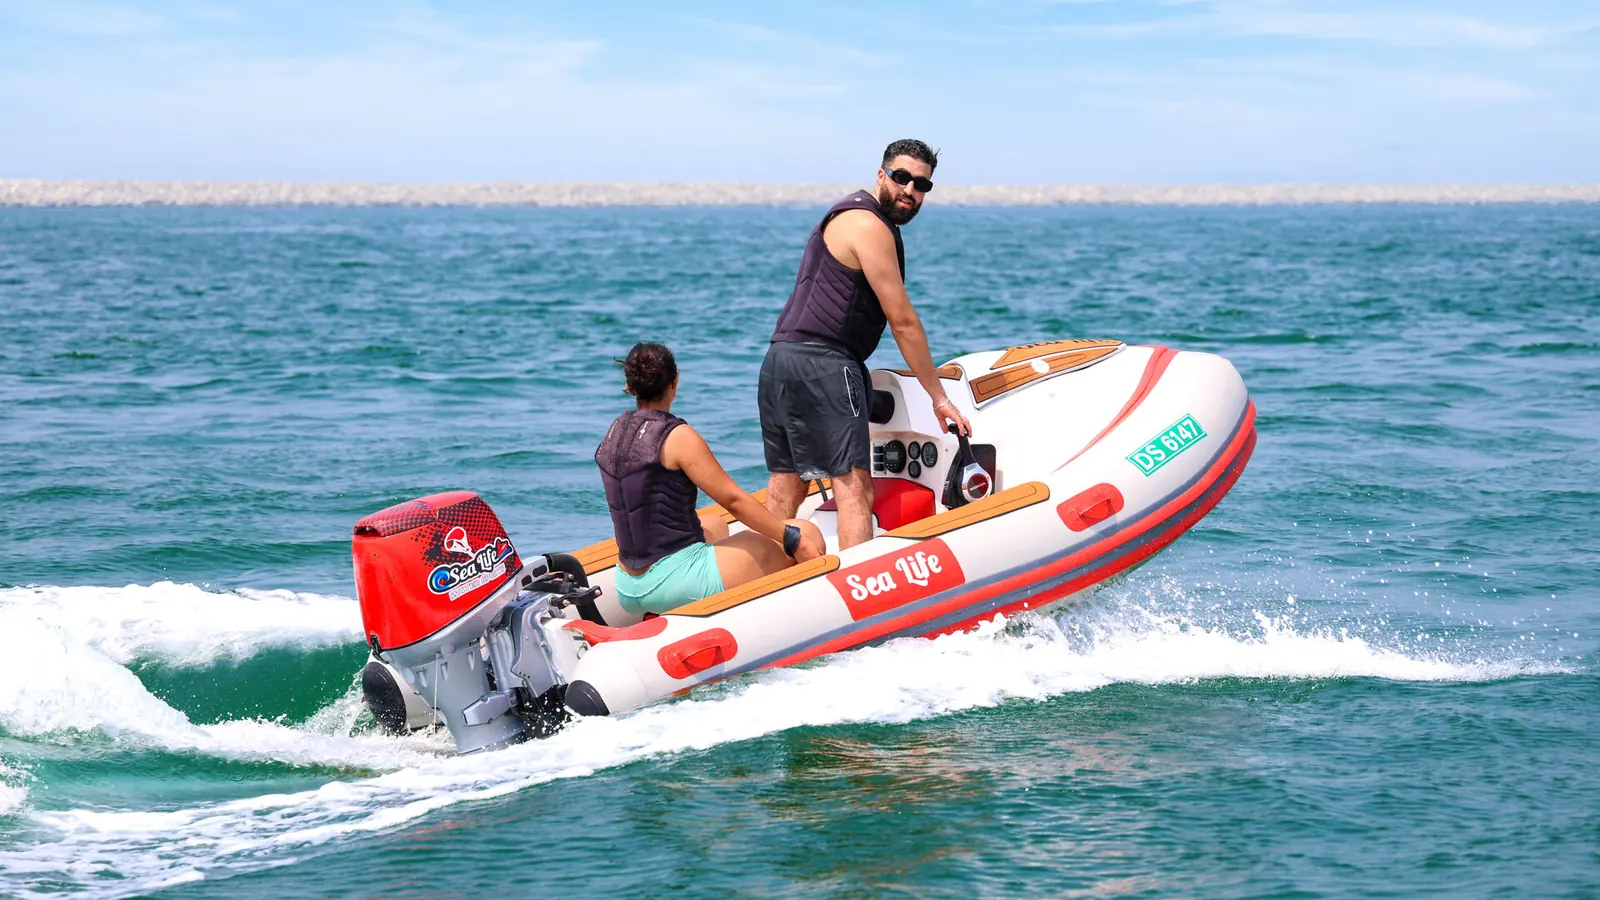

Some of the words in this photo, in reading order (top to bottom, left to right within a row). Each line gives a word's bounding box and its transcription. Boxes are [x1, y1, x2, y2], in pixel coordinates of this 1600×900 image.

[1132, 444, 1166, 471] DS
[1160, 419, 1199, 451] 6147
[450, 563, 477, 585] Sea
[477, 548, 497, 570] Life
[846, 571, 897, 601] Sea
[895, 551, 942, 587] Life
